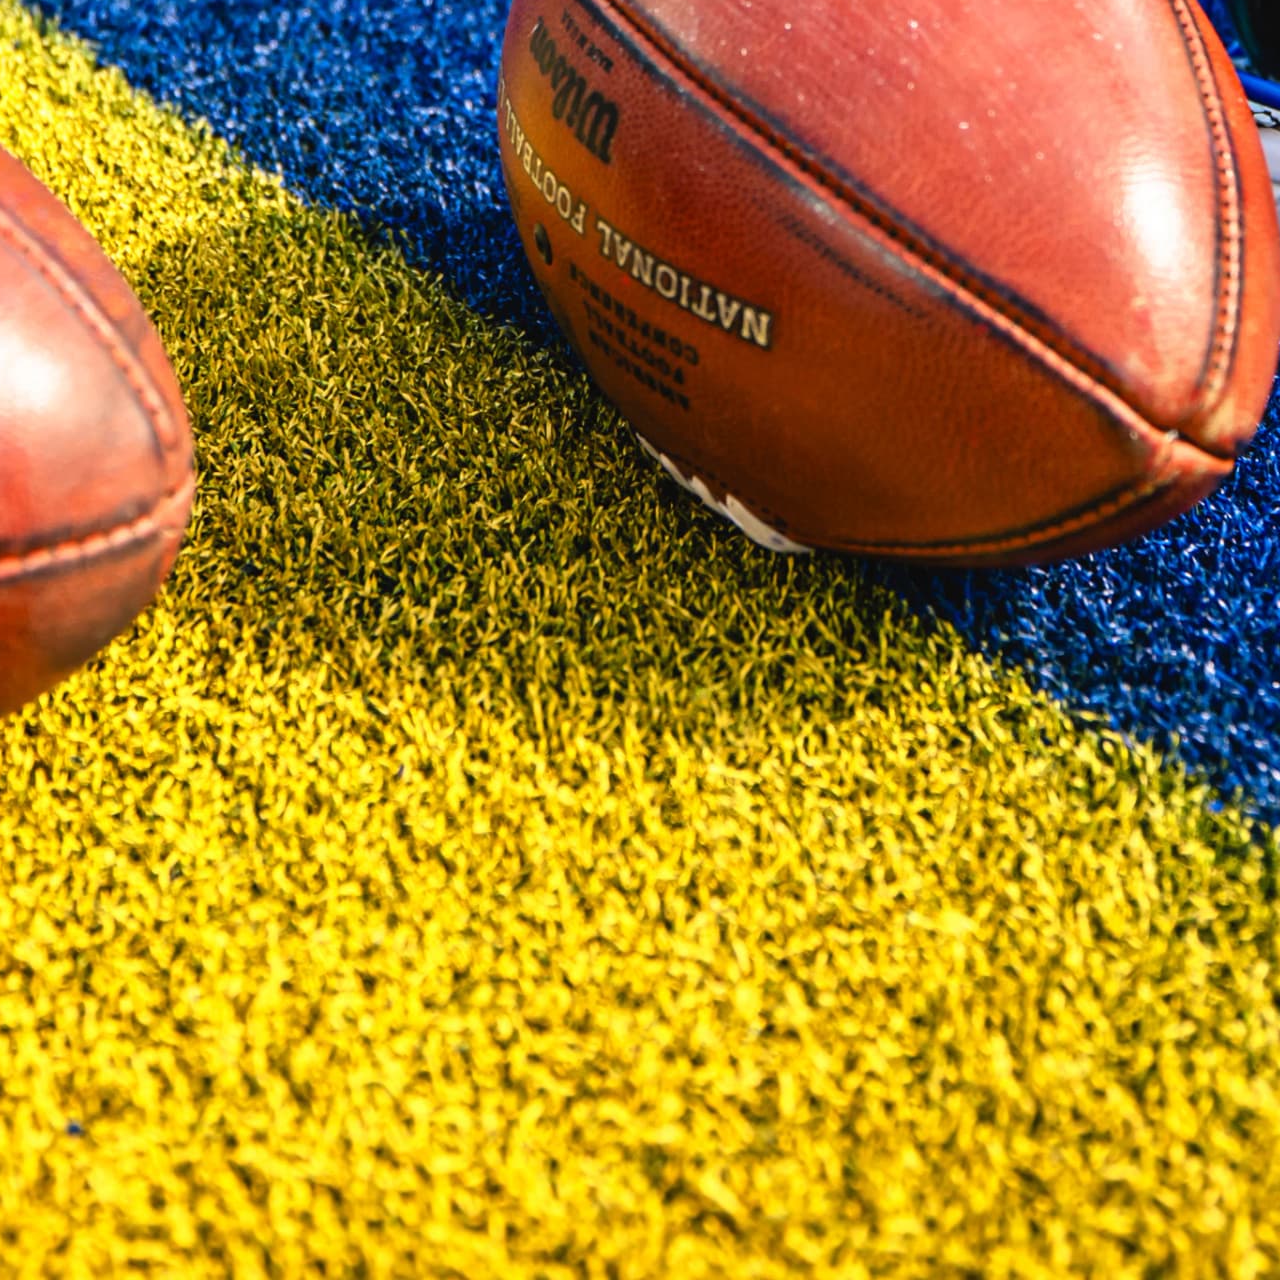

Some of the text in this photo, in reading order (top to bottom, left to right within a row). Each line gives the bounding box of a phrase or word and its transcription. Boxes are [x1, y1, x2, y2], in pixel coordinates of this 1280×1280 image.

[530, 16, 619, 164] Wilson
[504, 97, 771, 348] NATIONAL FOOTBALL
